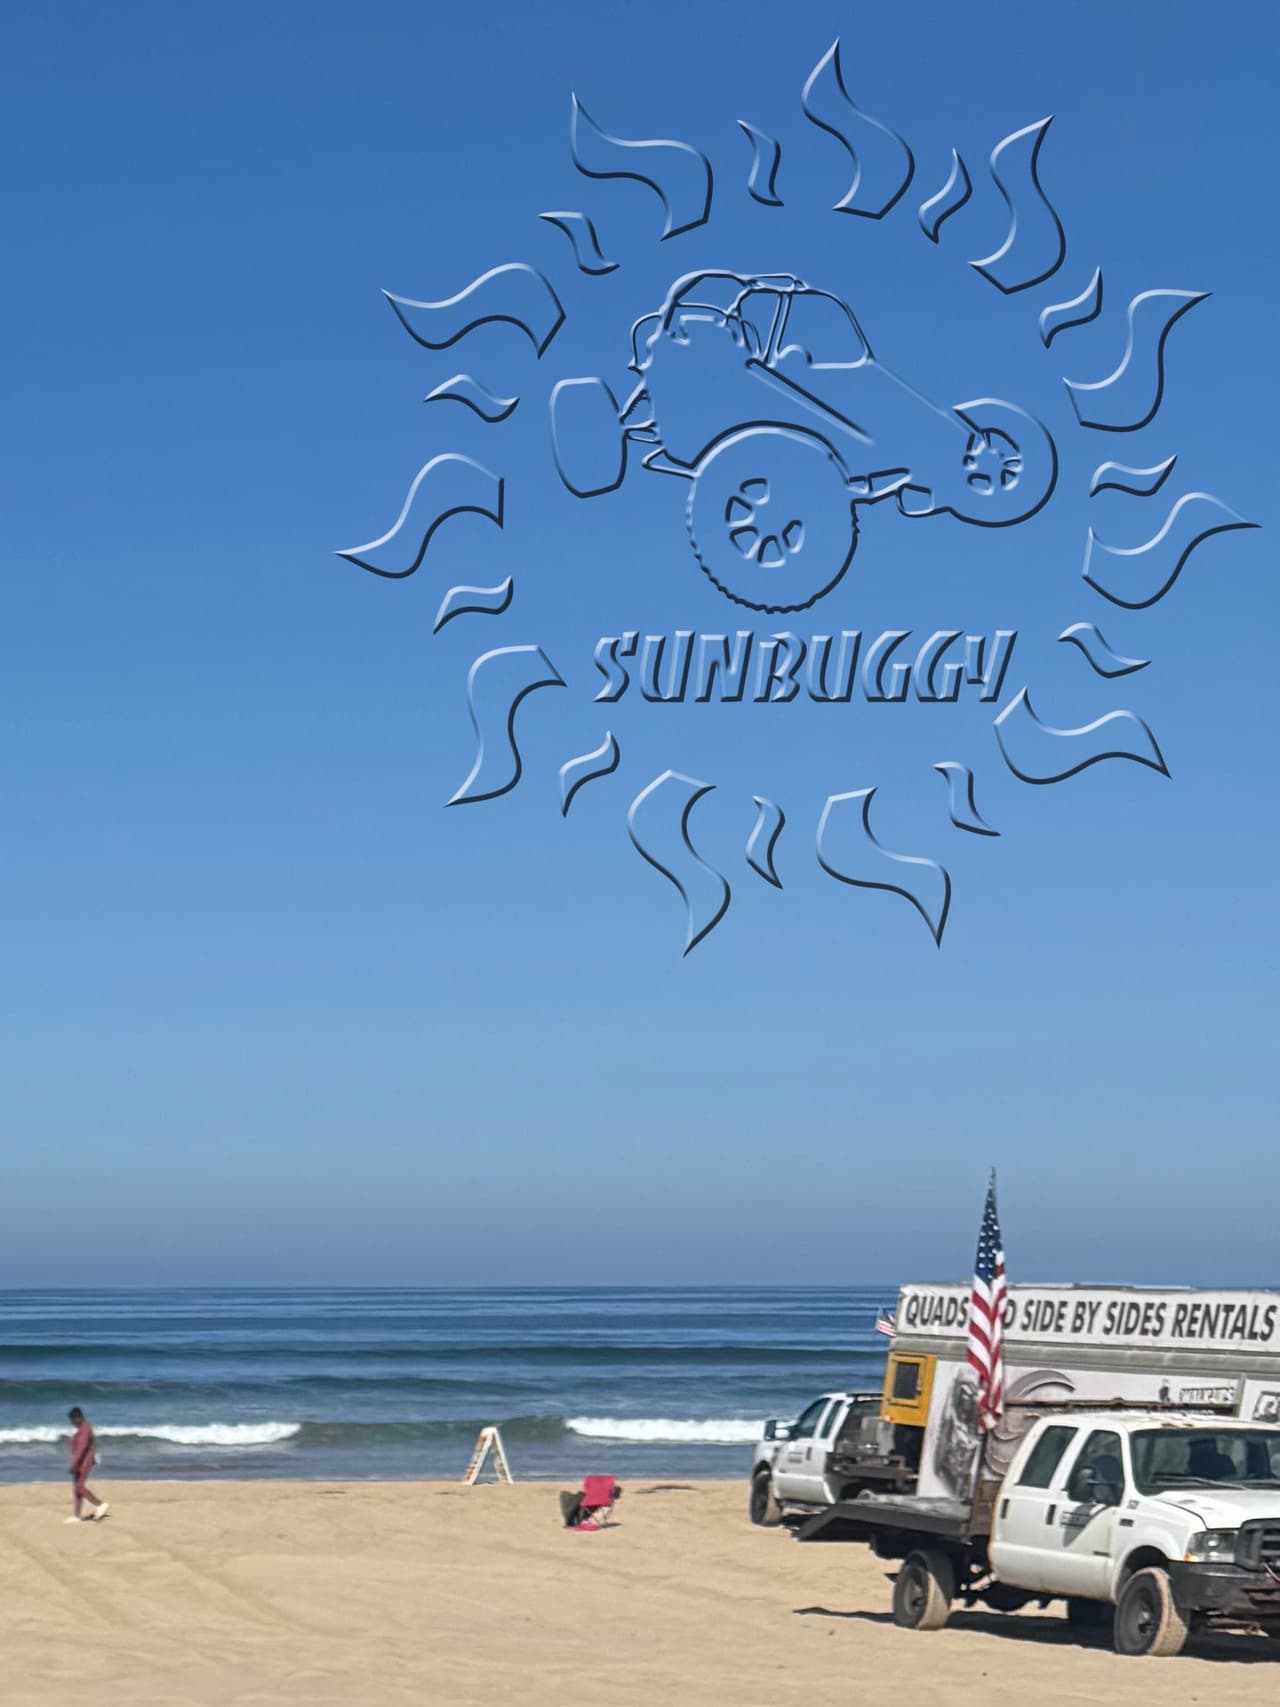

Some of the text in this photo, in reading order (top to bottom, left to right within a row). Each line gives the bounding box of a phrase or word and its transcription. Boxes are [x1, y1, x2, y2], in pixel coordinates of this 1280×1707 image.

[905, 1294, 970, 1328] QUADS
[1021, 1299, 1068, 1333] SIDE
[1071, 1300, 1102, 1335] BY
[1102, 1301, 1167, 1337] SIDES
[1170, 1303, 1278, 1342] RENTALS
